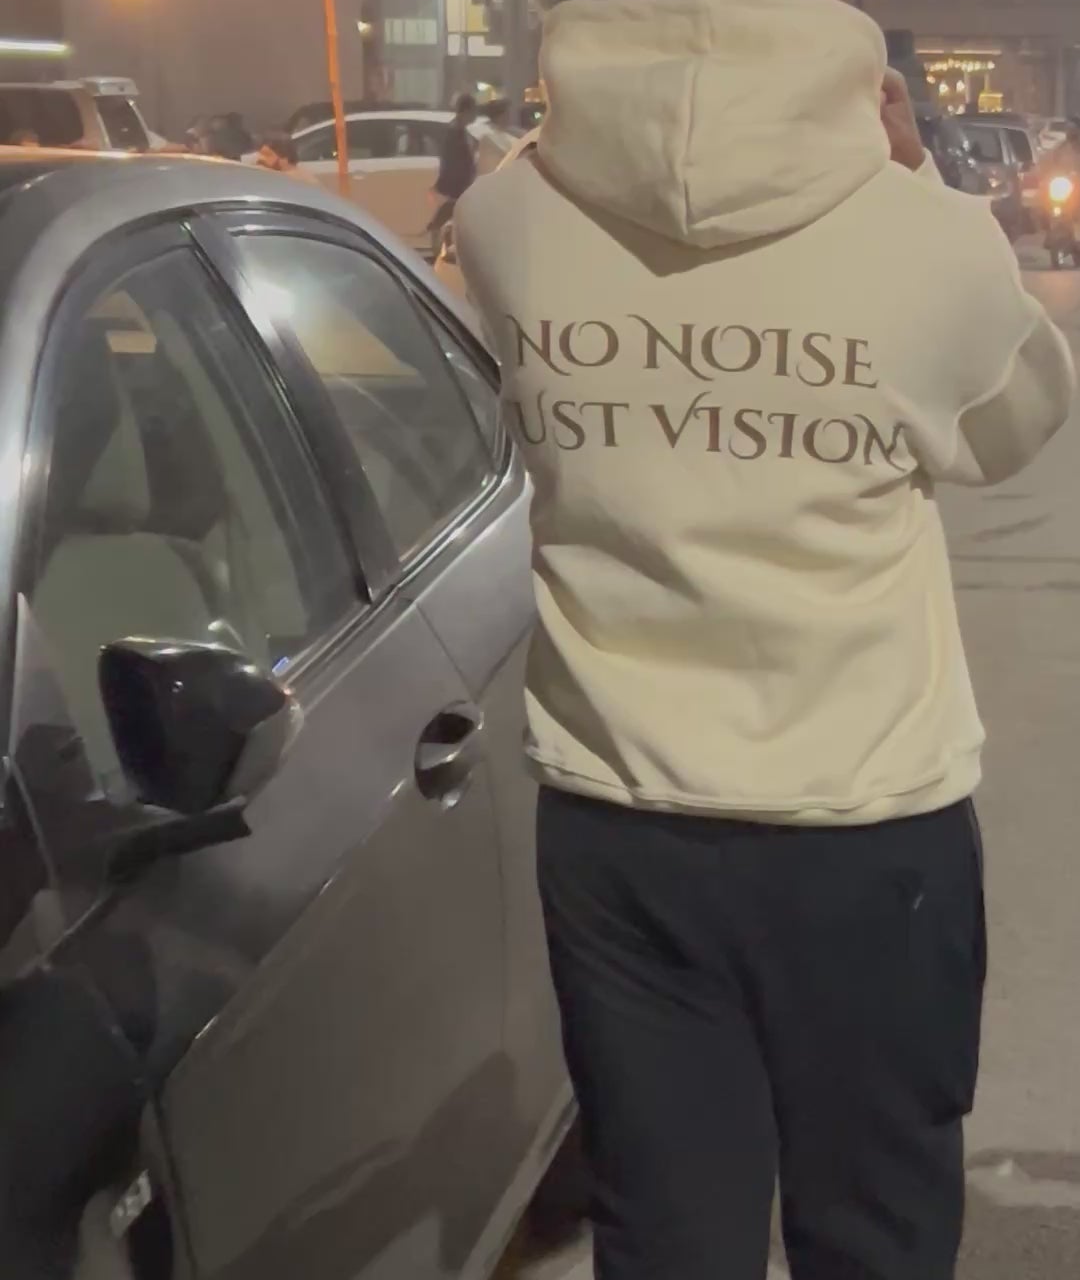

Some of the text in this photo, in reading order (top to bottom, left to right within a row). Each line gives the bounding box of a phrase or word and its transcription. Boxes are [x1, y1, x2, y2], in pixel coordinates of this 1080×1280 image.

[505, 313, 879, 388] NO NOISE
[504, 389, 908, 472] UST VISION
